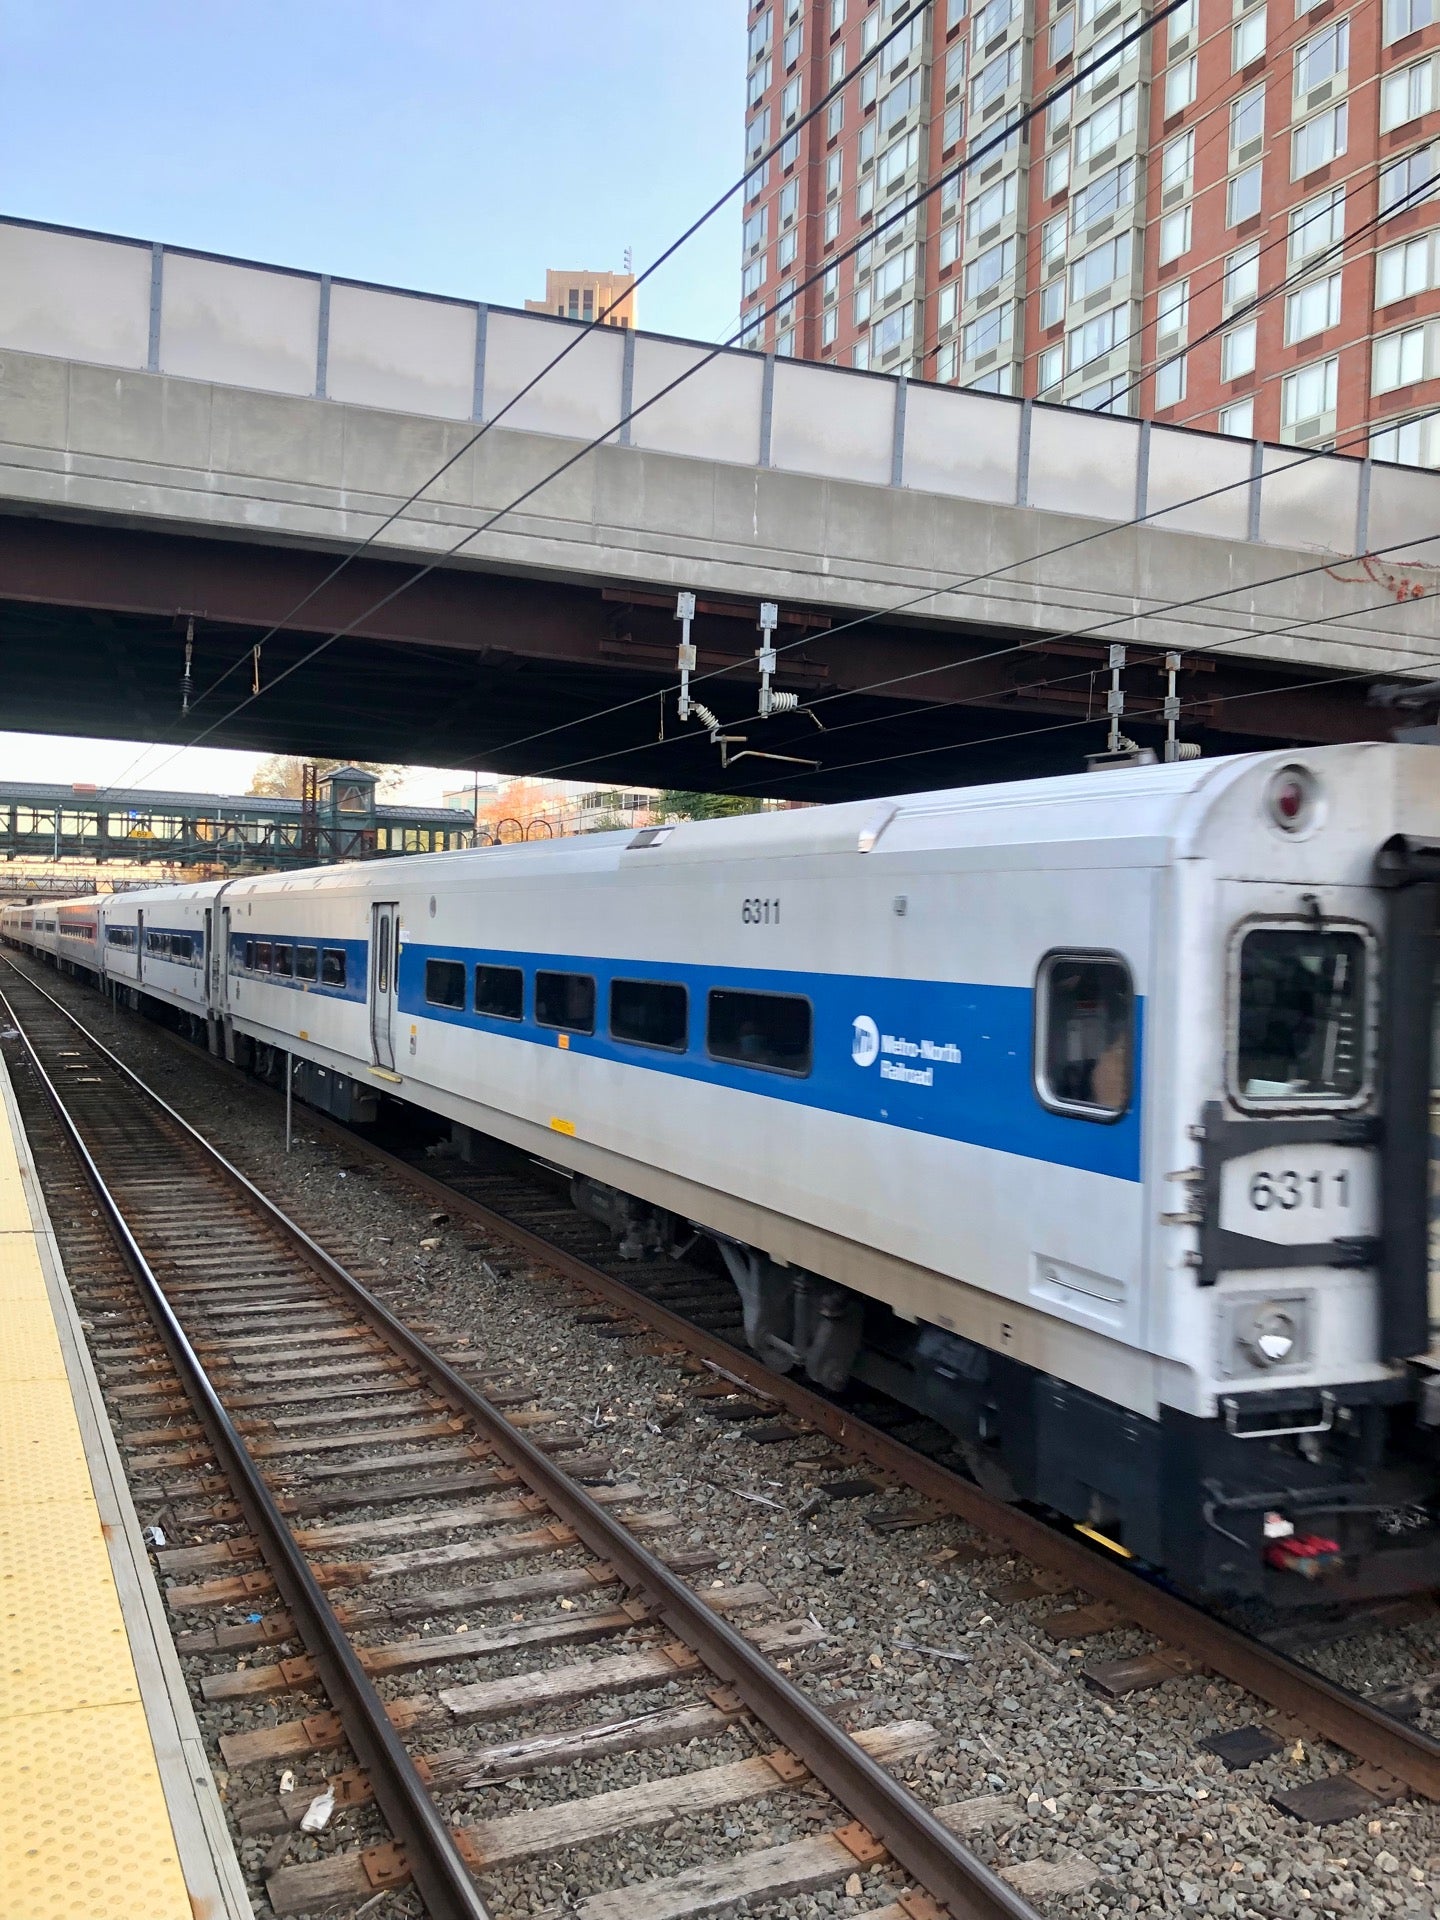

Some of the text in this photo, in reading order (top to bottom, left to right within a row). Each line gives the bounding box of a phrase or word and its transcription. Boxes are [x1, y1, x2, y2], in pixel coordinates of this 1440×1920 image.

[741, 898, 780, 925] 6311
[880, 1034, 962, 1064] Metro-North
[1248, 1169, 1349, 1211] 6311
